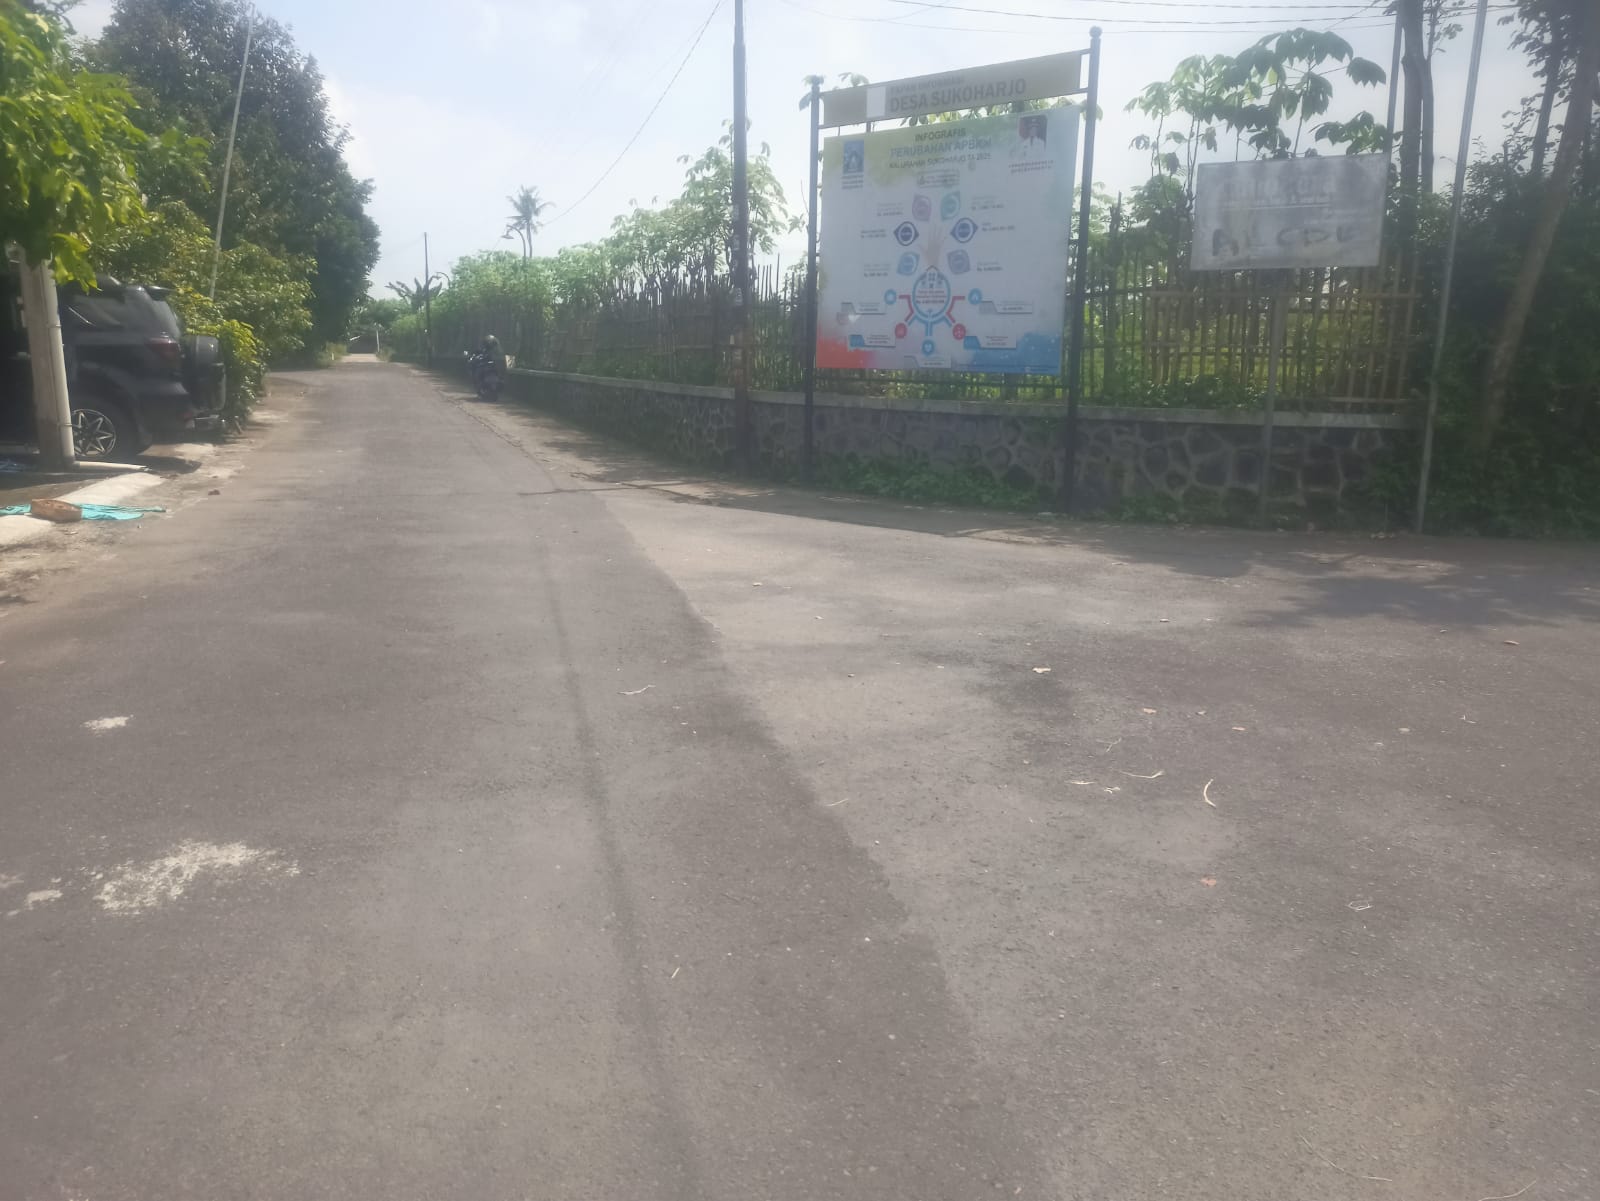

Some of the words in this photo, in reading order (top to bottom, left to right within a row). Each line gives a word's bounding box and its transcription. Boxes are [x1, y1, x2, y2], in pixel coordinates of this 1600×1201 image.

[890, 93, 928, 112] DESA
[931, 78, 1026, 106] SUKOHARJO
[915, 128, 966, 142] INFOGRAFIS
[890, 141, 952, 158] PERUBAHAN
